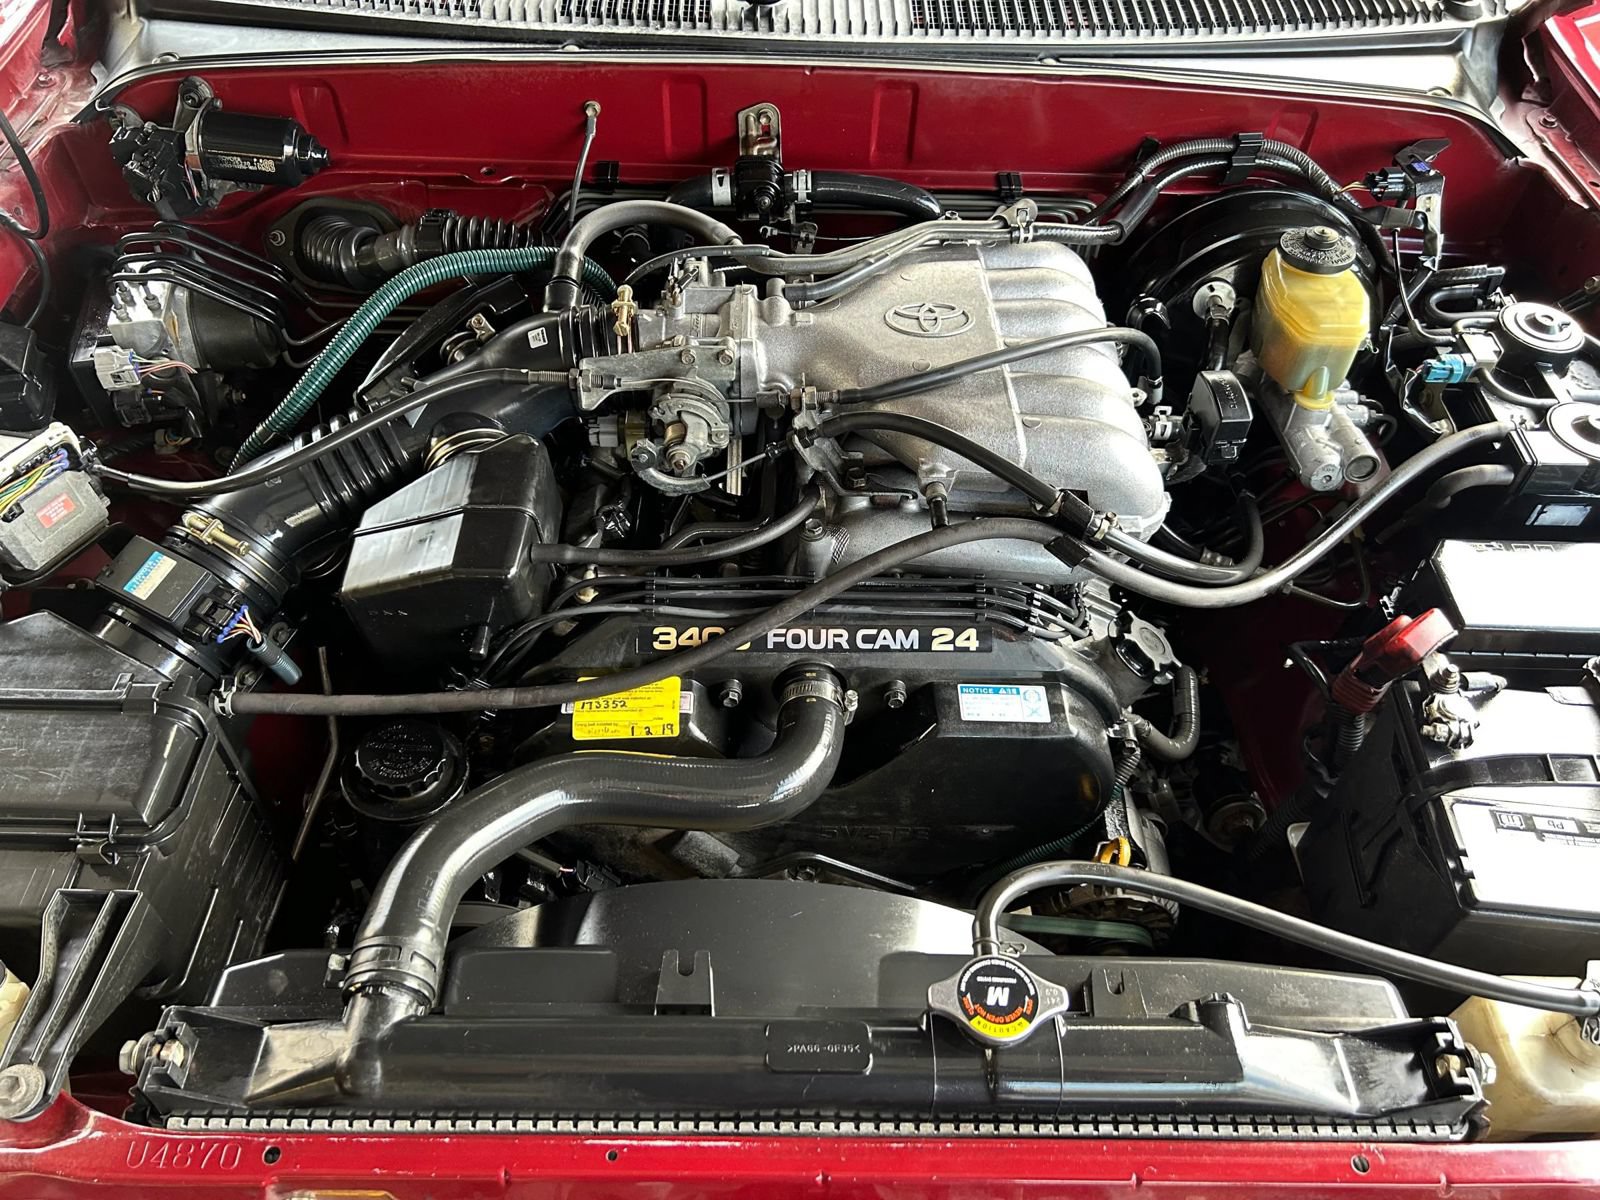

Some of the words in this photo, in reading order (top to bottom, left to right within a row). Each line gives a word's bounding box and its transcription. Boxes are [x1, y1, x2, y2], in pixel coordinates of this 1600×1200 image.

[652, 627, 750, 650] 340
[767, 628, 849, 650] FOUR
[855, 628, 919, 650] CAM
[931, 628, 979, 651] 24
[962, 687, 994, 695] NOTICE
[580, 699, 627, 710] 173352
[126, 1141, 242, 1170] U4870
